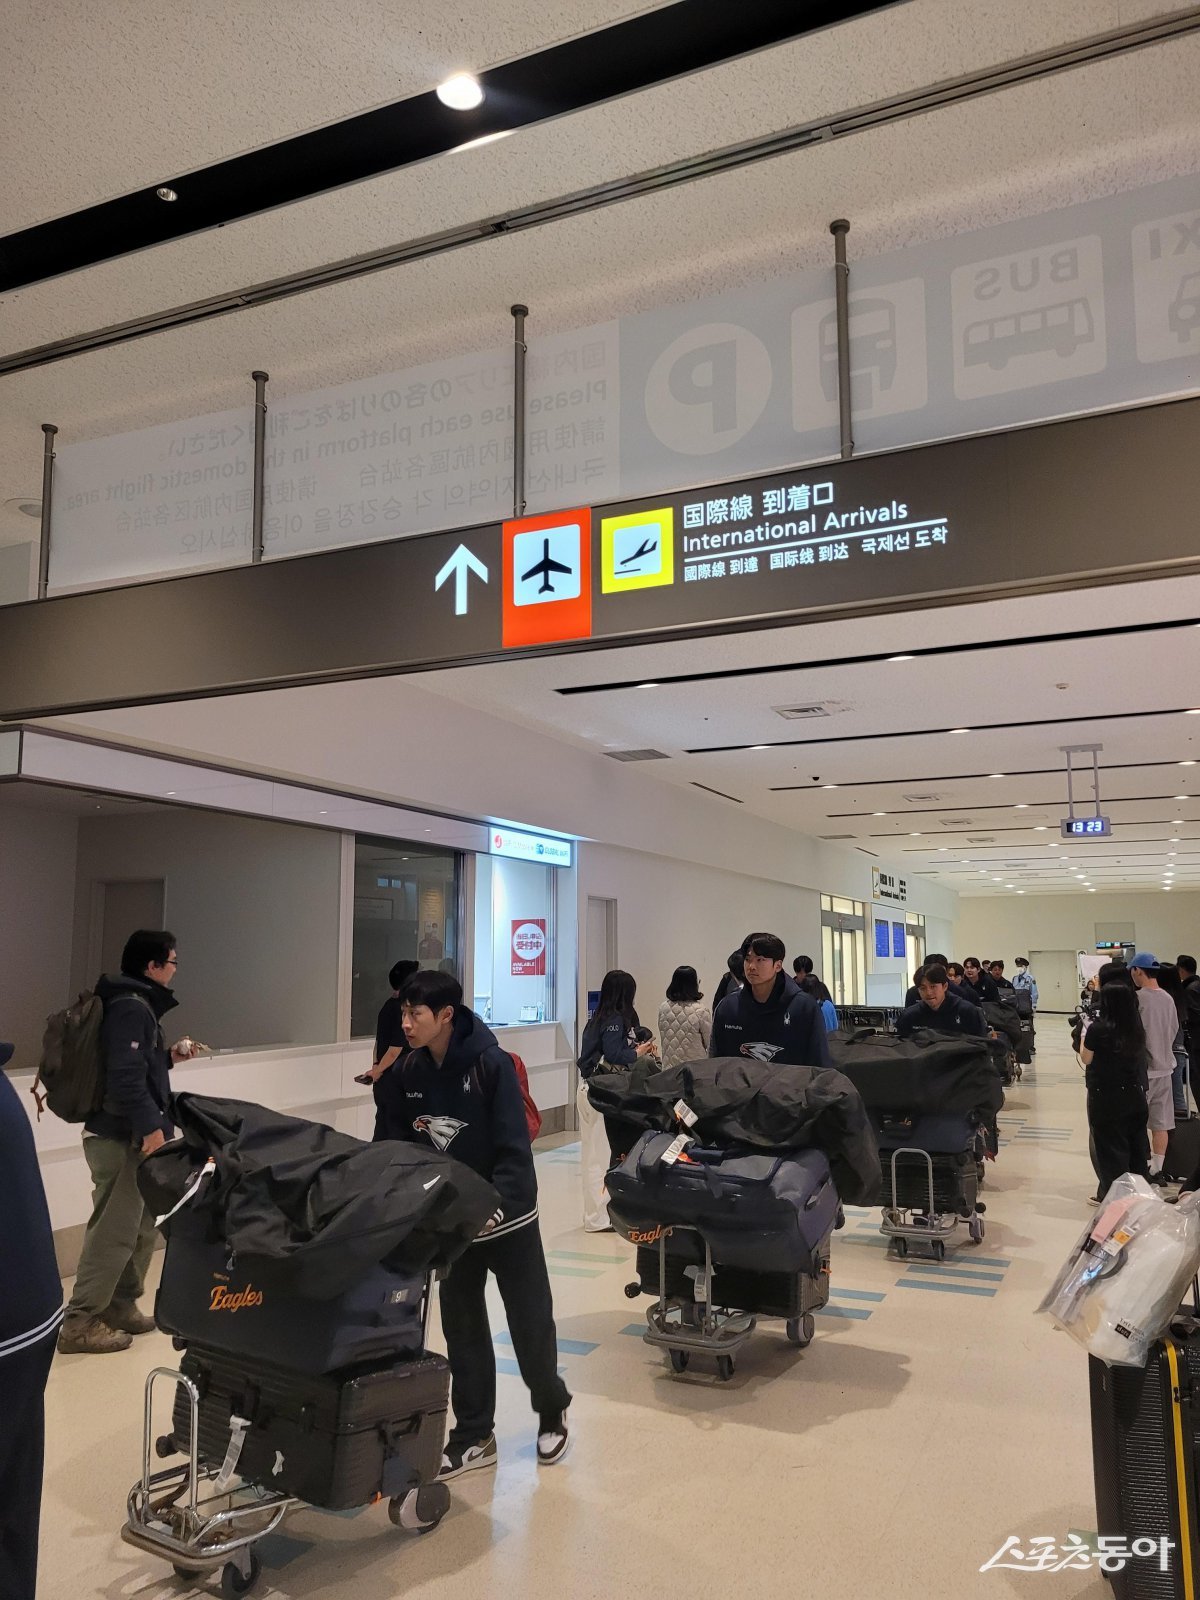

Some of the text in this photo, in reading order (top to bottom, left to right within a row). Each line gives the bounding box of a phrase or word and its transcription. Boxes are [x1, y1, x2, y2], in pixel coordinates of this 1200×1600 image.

[683, 481, 835, 529] 国際線 到着口
[683, 501, 908, 553] International Arrivals
[861, 525, 949, 556] 국제선 도착
[684, 543, 850, 582] 國際線 到達 国际线 到达
[209, 1283, 263, 1313] Eagles
